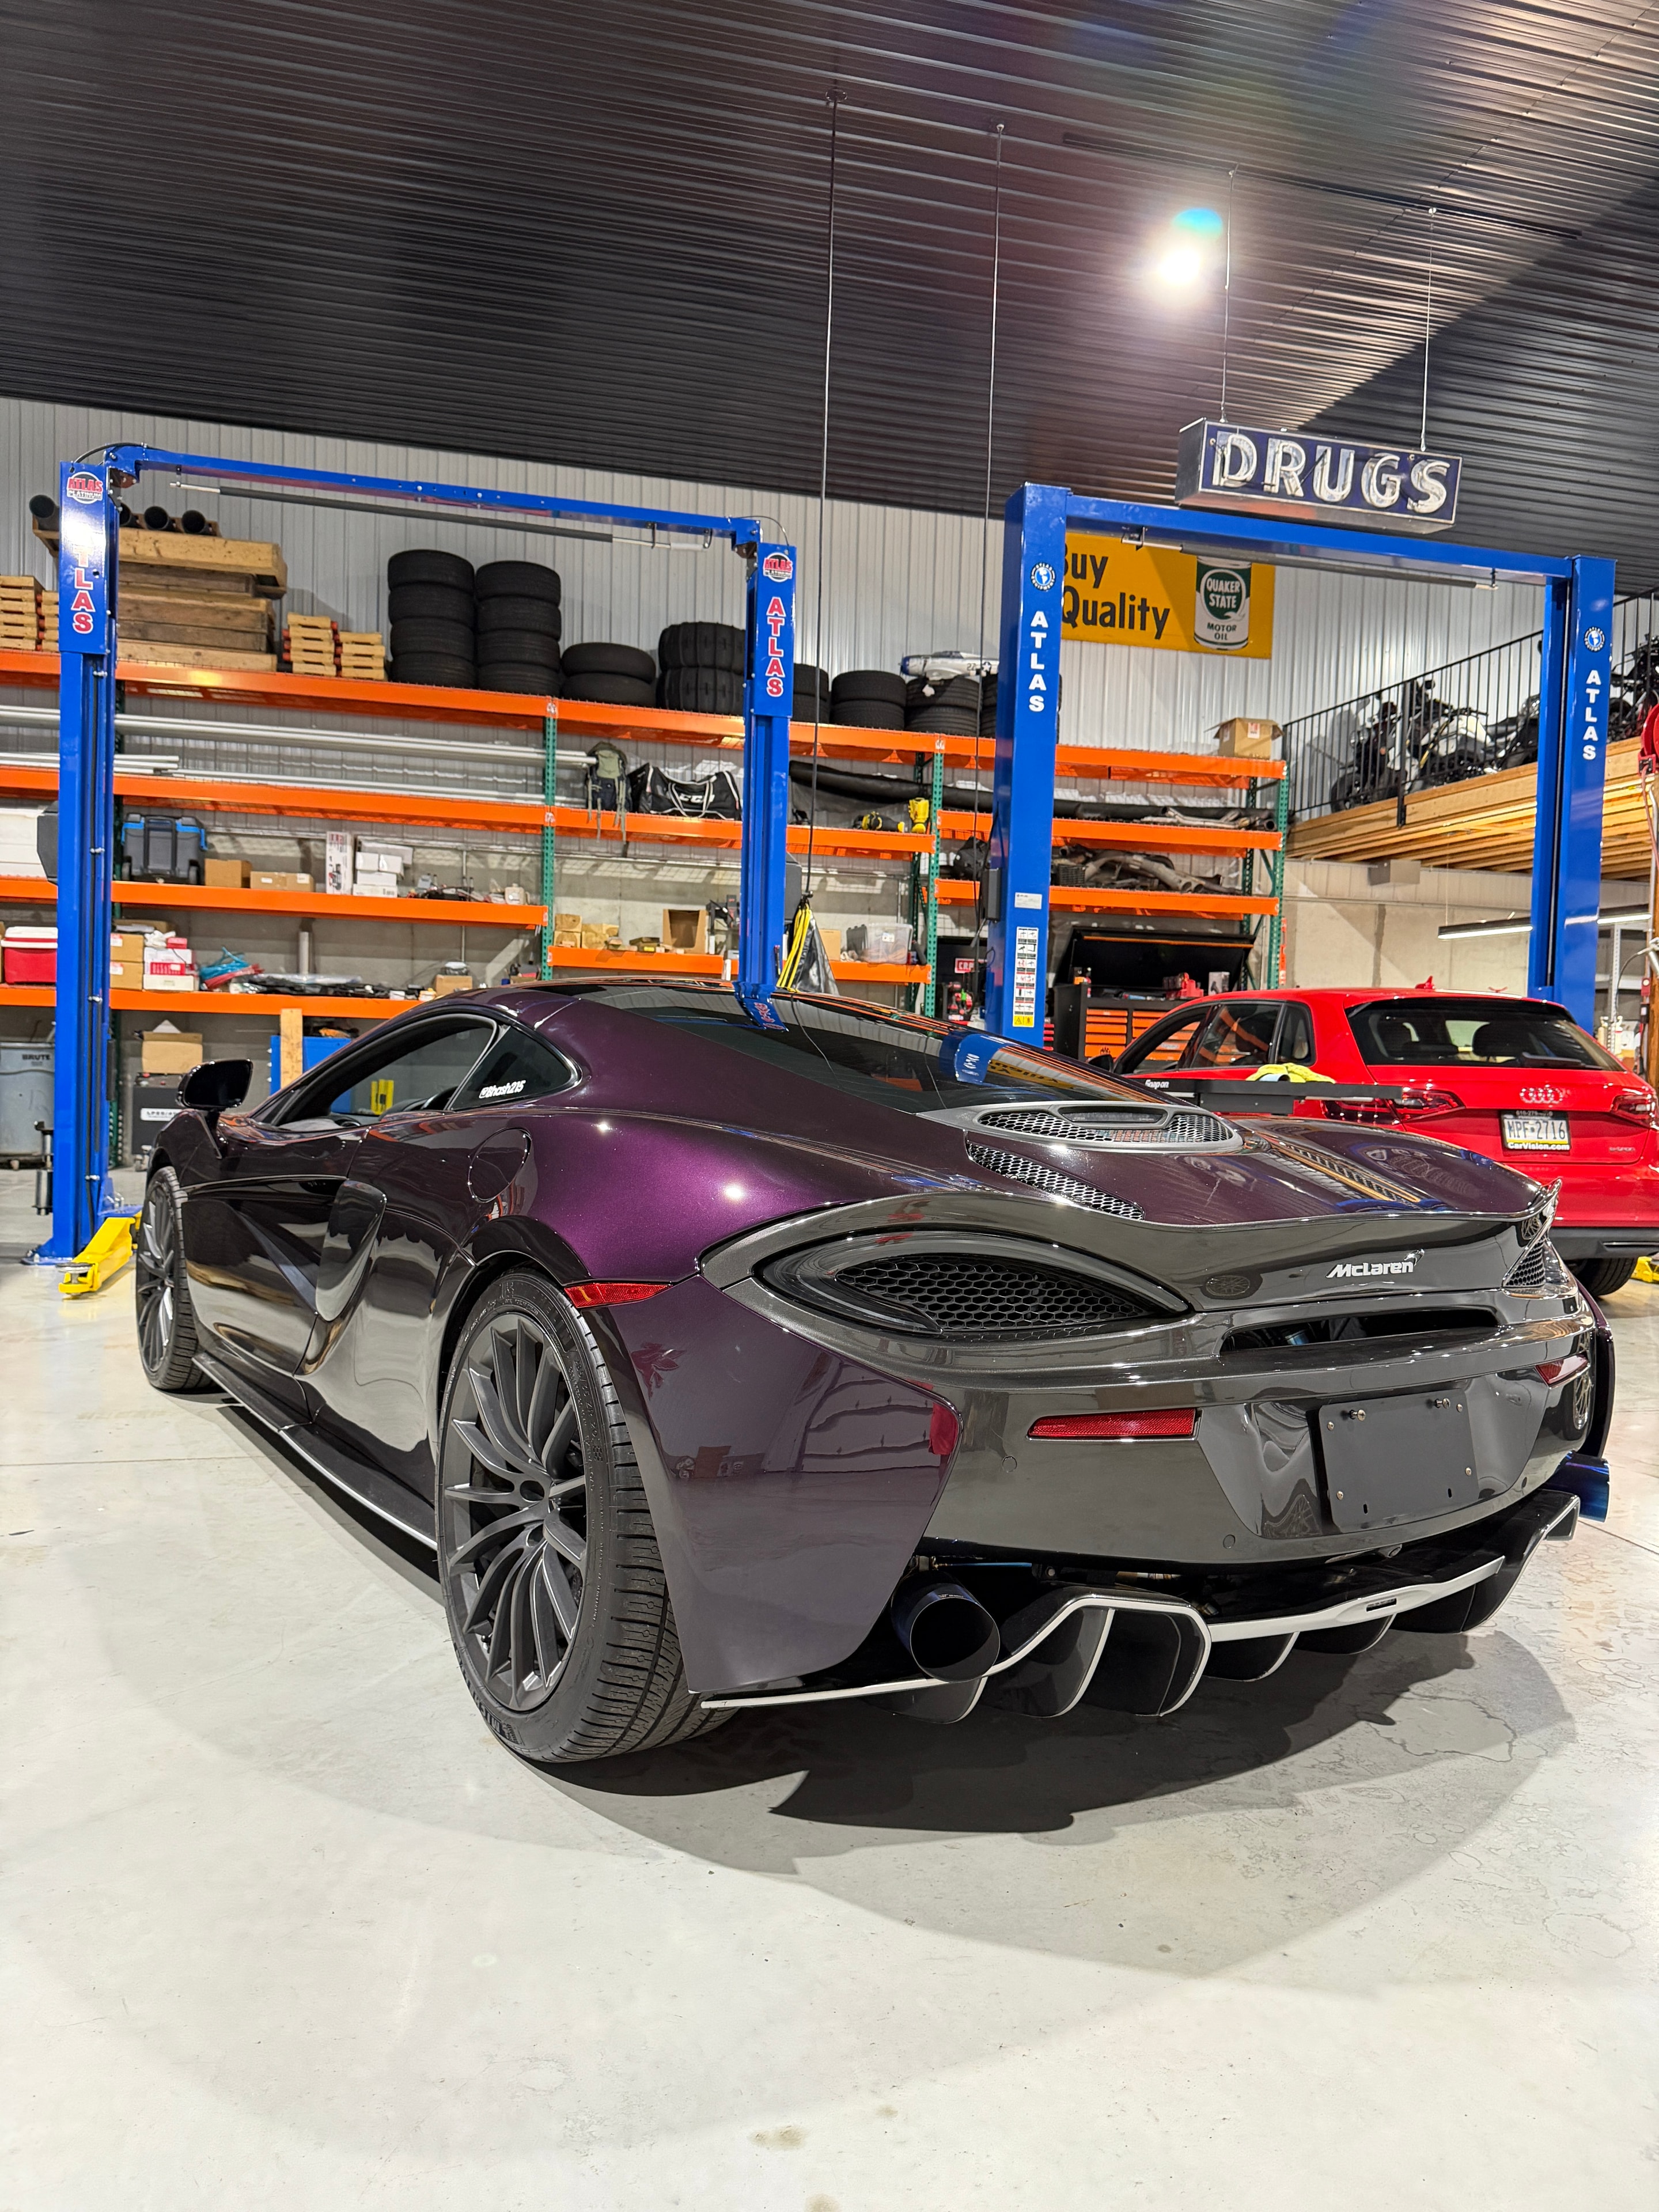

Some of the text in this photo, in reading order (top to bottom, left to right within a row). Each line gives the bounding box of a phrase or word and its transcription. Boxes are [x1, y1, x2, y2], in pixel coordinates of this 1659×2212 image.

[1212, 431, 1450, 513] DRUGS
[68, 477, 103, 493] ATLAS
[764, 558, 793, 572] ATLAS
[70, 521, 96, 634] TLAS
[1206, 578, 1241, 593] QUAKER
[1209, 593, 1237, 609] STATE
[1062, 585, 1170, 640] Quality
[1207, 622, 1237, 632] MOTOR
[1214, 632, 1228, 641] OIL
[765, 596, 787, 698] ATLAS
[1028, 611, 1049, 713] ATLAS
[1582, 669, 1602, 760] ATLAS
[1536, 1121, 1565, 1139] 2716
[1508, 1142, 1570, 1151] CarVision.com
[1326, 1262, 1414, 1278] McLaren
